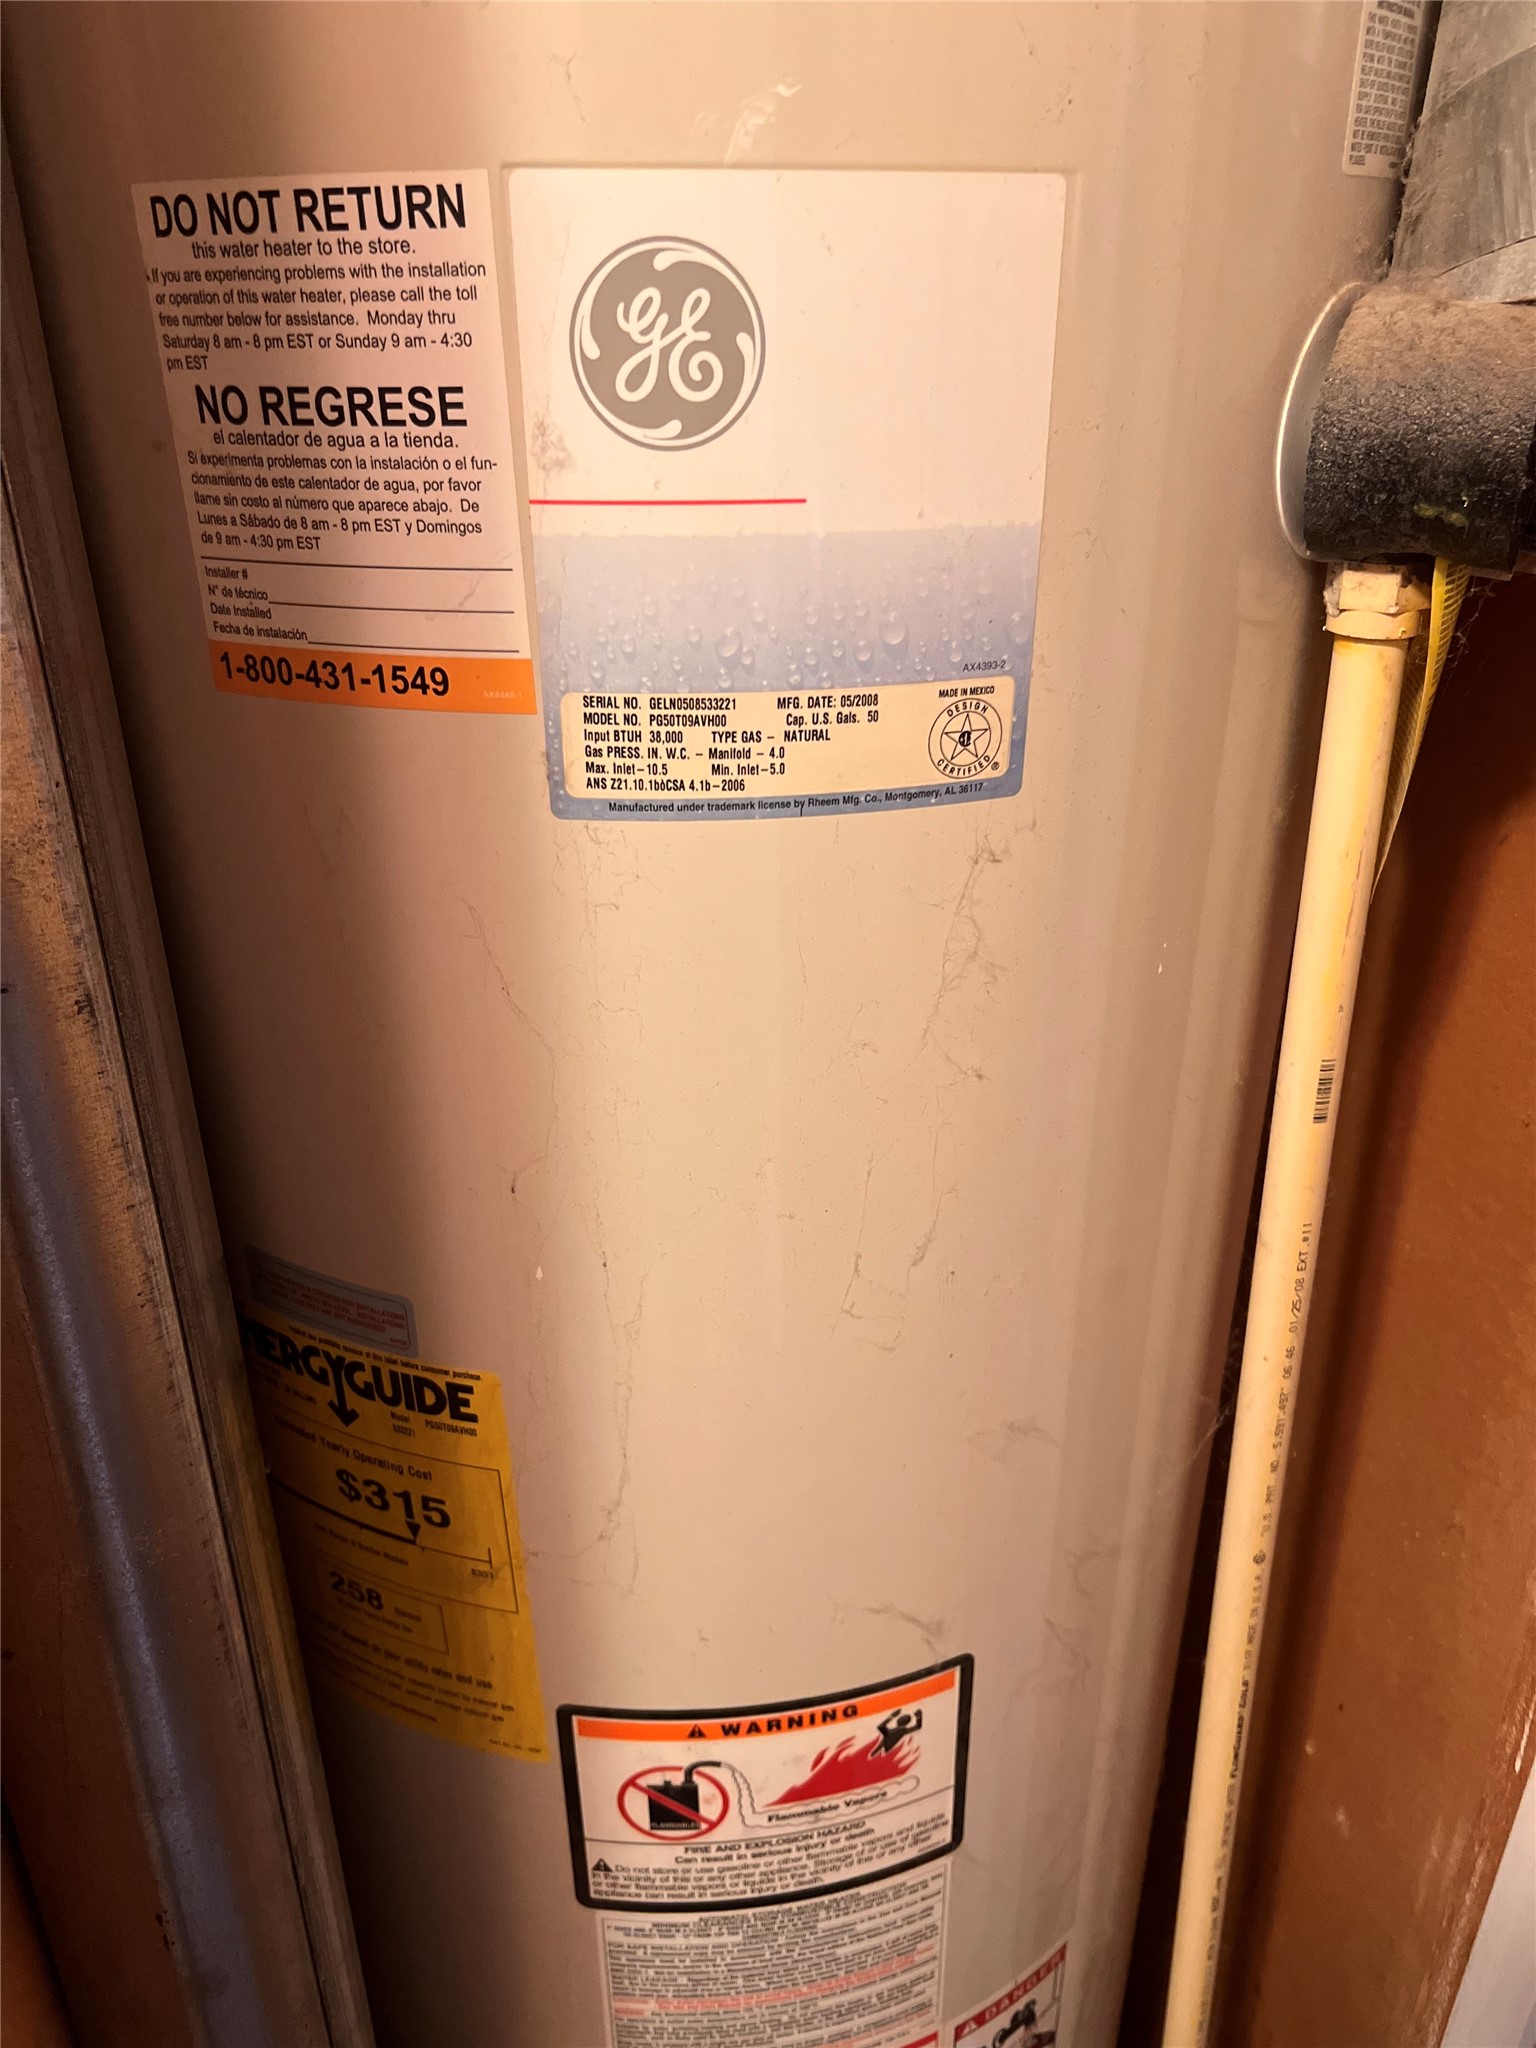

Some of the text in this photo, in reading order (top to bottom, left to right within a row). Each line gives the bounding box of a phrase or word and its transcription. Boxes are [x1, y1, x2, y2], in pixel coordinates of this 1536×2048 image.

[149, 183, 465, 238] DO NOT RETURN
[191, 237, 415, 259] this water heater to the store.
[152, 261, 485, 286] If you are experiencing problems with the installation
[158, 309, 455, 328] free number below for assistance. Monday thru
[162, 332, 472, 351] Saturday 8 am 8 pm EST or Sunday 9 am 4:30
[614, 286, 723, 403] GE
[166, 354, 208, 373] pm EST
[194, 384, 467, 427] NO REGRESE
[213, 428, 458, 451] el calentador de agua a la tienda.
[187, 450, 497, 470] Si experimenta problemas con la instalación o el fun-
[196, 510, 482, 537] Lunes a Sábado de 8 am 8 pm EST y Domingos
[201, 530, 320, 551] de 9 am 4:30 pm EST
[204, 564, 248, 580] Installer #
[210, 601, 271, 619] Date Installed
[213, 620, 308, 641] Fecha de instalación
[220, 651, 449, 696] 1-800-431-1549
[962, 660, 1006, 673] AX4393-2
[777, 693, 878, 709] MFG. DATE: 05/2008
[938, 685, 994, 698] MADE IN MEXICO
[583, 695, 735, 710] SERIAL NO. GELN0508533221
[946, 700, 989, 718] DESIGN
[583, 712, 726, 727] MODEL NO. PG50T09AVH00
[786, 710, 878, 727] Cap. U.S. Gals. 50
[584, 728, 682, 744] Input BTUH 38,000
[711, 728, 830, 743] TYPE GAS NATURAL
[585, 745, 784, 759] Gas PRESS. IN. W.C. Manifold 4.0
[585, 761, 608, 773] Max.
[711, 763, 732, 775] Min.
[937, 754, 991, 776] CERTIFIED
[586, 777, 606, 789] ANS
[608, 782, 984, 812] Manufactured under trademark license by Rheem Mfg. Co., Montgomery, AL 36117
[407, 1463, 433, 1482] Cost
[336, 1468, 451, 1529] $315
[328, 1570, 385, 1611] 258
[720, 1704, 859, 1737] WARNING
[767, 1803, 840, 1822] Flammable
[685, 1820, 866, 1854] FIRE AND EXPLOSION HAZARD
